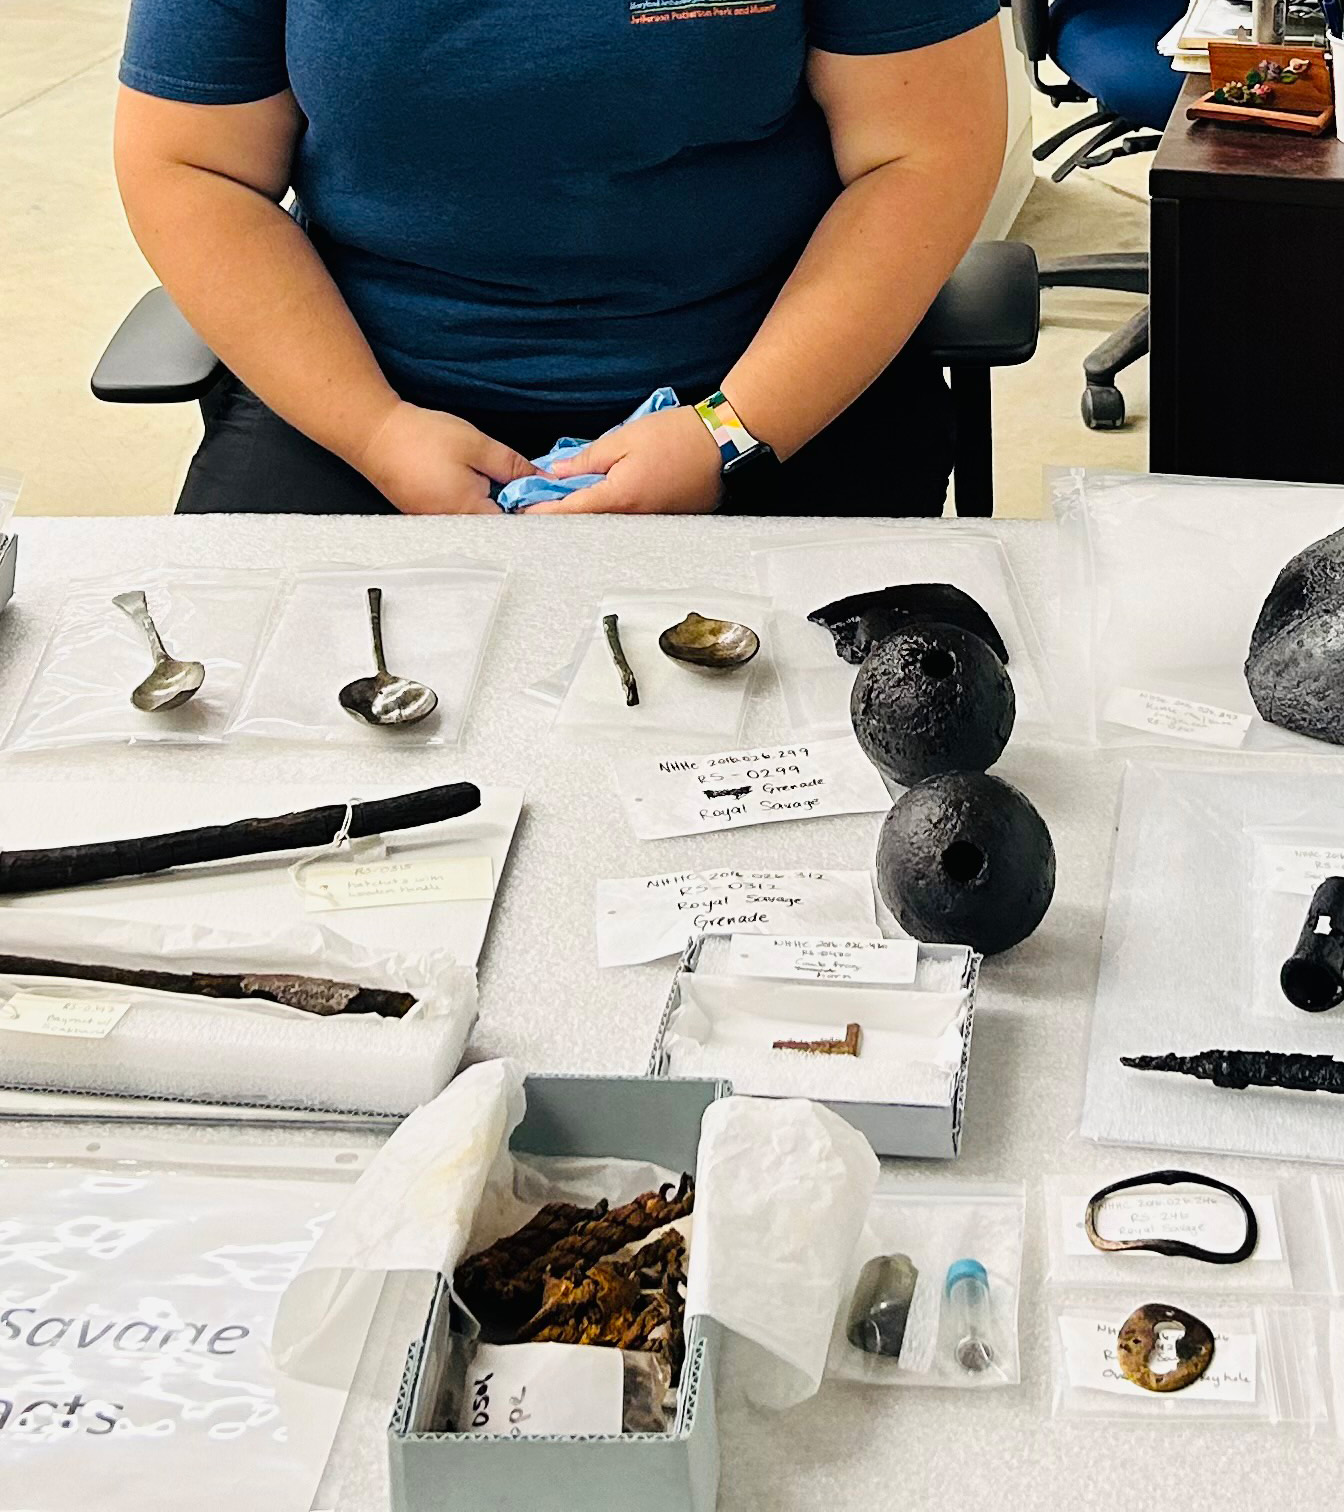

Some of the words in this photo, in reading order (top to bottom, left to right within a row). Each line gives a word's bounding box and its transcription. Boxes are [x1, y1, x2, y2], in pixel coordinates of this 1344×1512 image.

[630, 14, 670, 25] Jefferson
[671, 9, 713, 20] Patterson
[712, 6, 734, 17] Park
[733, 6, 750, 16] and
[762, 777, 827, 795] Grenade
[699, 803, 748, 821] Royal
[759, 797, 820, 812] Savage
[677, 896, 729, 914] Royal
[746, 893, 804, 908] Savage
[693, 912, 770, 932] Grenade
